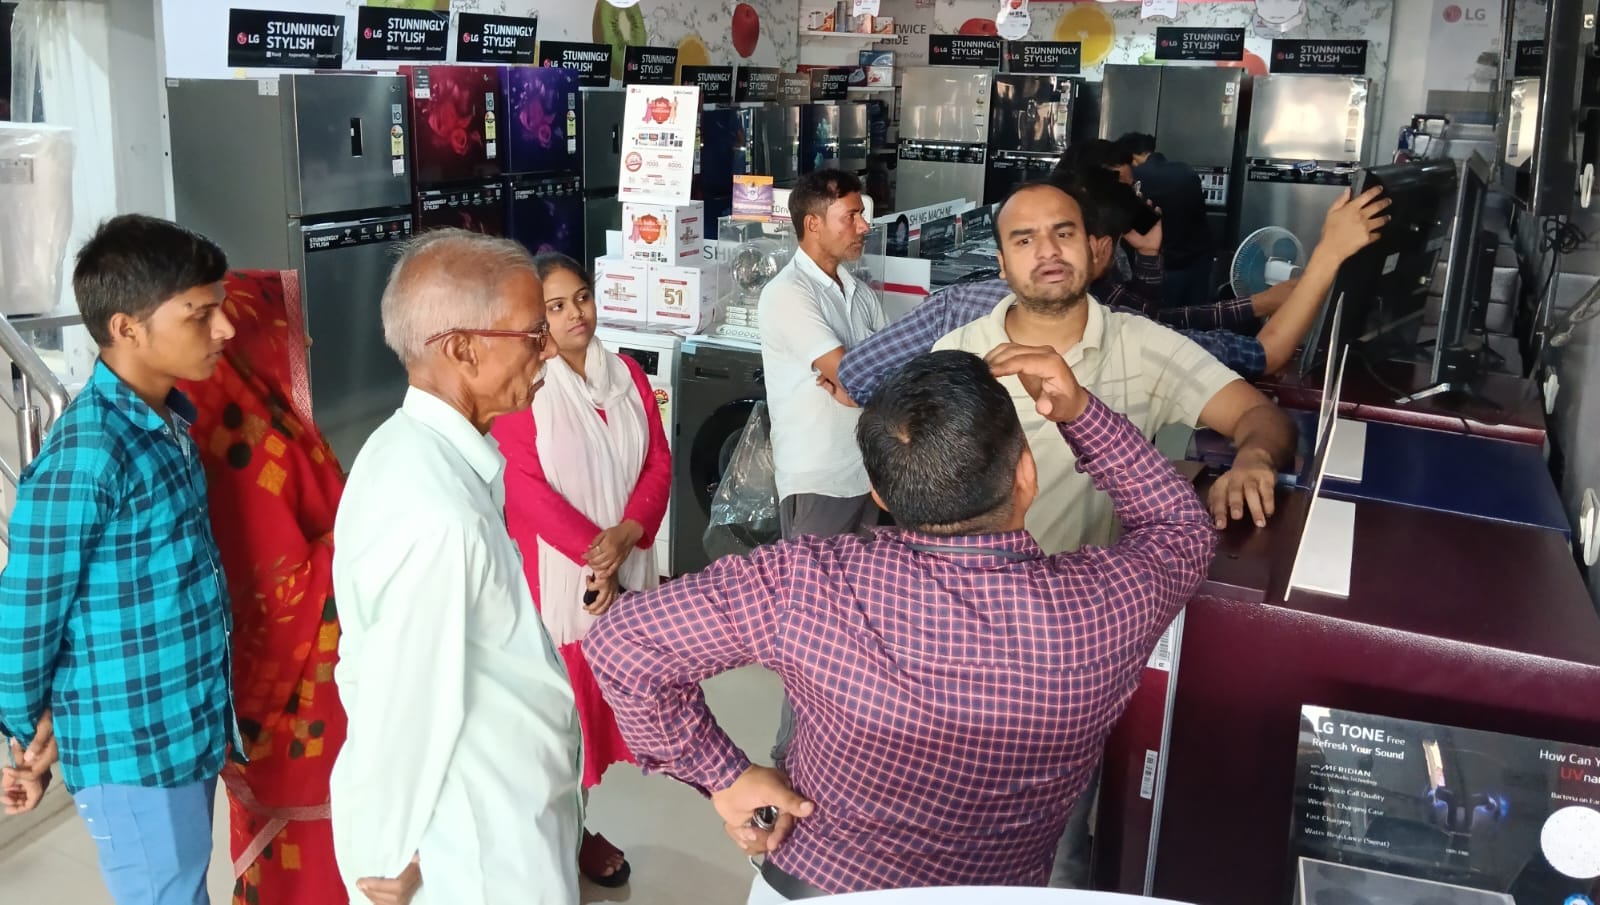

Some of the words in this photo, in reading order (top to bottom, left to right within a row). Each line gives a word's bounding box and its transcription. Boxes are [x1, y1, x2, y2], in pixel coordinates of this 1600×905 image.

[1465, 8, 1486, 20] LG
[267, 21, 339, 37] STUNNINGLY
[388, 18, 446, 31] STUNNINGLY
[483, 23, 533, 37] STUNNINGLY
[248, 34, 260, 43] LG
[373, 30, 382, 38] LG
[387, 31, 425, 43] STYLISH
[470, 34, 479, 43] LG
[1182, 32, 1240, 42] STUNNINGLY
[266, 36, 315, 49] STYLISH
[482, 36, 516, 47] STYLISH
[951, 40, 1000, 49] STUNNINGLY
[1182, 41, 1220, 50] STYLISH
[951, 48, 983, 56] STYLISH
[1023, 46, 1077, 55] STUNNINGLY
[1300, 45, 1363, 55] STUNNINGLY
[562, 50, 610, 62] STUNNINGLY
[641, 54, 675, 64] STUNNINGLY
[1023, 54, 1059, 63] STYLISH
[1299, 54, 1340, 63] STYLISH
[562, 60, 593, 72] STYLISH
[640, 64, 663, 74] STYLISH
[697, 73, 731, 81] STUNNINGLY
[393, 111, 401, 121] 10
[664, 287, 683, 306] 51
[1314, 721, 1334, 735] LG
[1340, 723, 1385, 743] TONE
[1387, 735, 1406, 746] Free
[1312, 737, 1348, 751] Refresh
[1351, 743, 1373, 755] Your
[1375, 747, 1405, 760] Sound
[1540, 749, 1566, 763] How
[1569, 753, 1591, 766] Can
[1320, 764, 1371, 777] MERIDIAN
[1308, 783, 1325, 791] Clear
[1328, 786, 1346, 795] Voice
[1347, 789, 1360, 797] Call
[1360, 791, 1385, 802] Quality
[1337, 803, 1367, 814] Charging
[1368, 808, 1384, 816] Case
